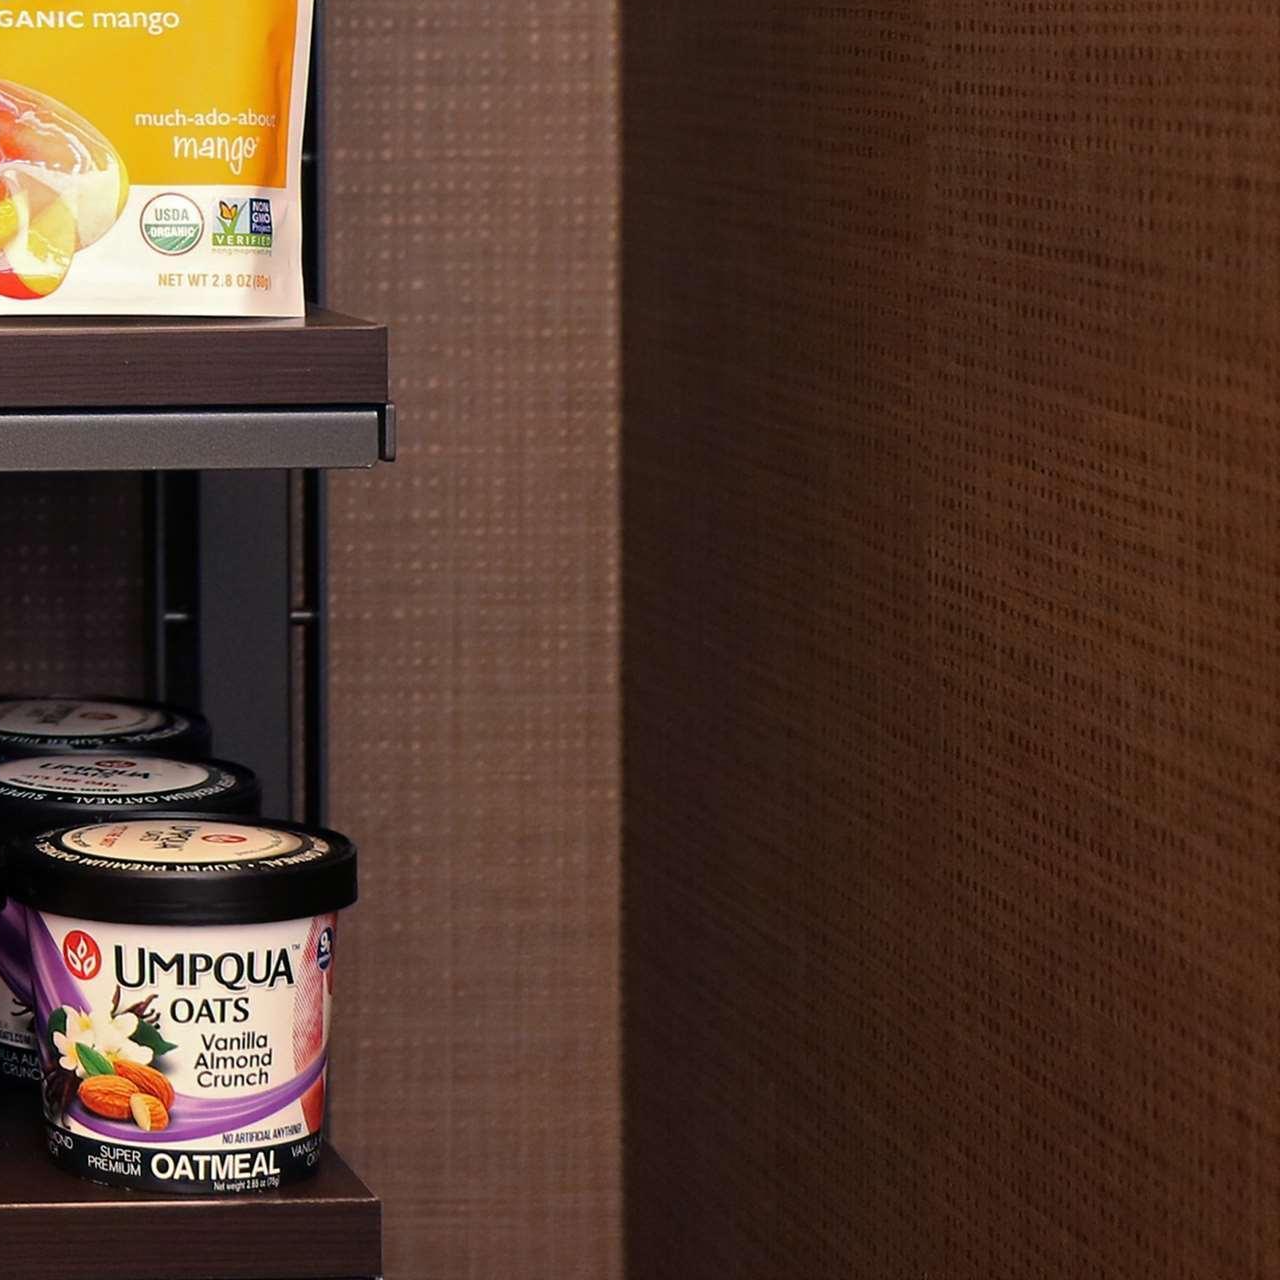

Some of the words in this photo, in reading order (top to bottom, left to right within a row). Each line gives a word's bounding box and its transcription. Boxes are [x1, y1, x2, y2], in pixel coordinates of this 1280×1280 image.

[92, 11, 180, 35] mango
[173, 135, 257, 174] mango
[154, 208, 189, 222] USDA
[149, 226, 196, 237] ORGANIC
[158, 274, 183, 286] NET
[188, 274, 208, 286] WT
[114, 945, 295, 990] UMPQUA
[170, 997, 249, 1023] OATS
[201, 1032, 268, 1051] Vanilla
[194, 1049, 273, 1070] Almond
[197, 1072, 269, 1087] Crunch
[100, 1146, 141, 1163] SUPER
[88, 1155, 141, 1176] PREMIUM
[151, 1151, 280, 1180] OATMEAL
